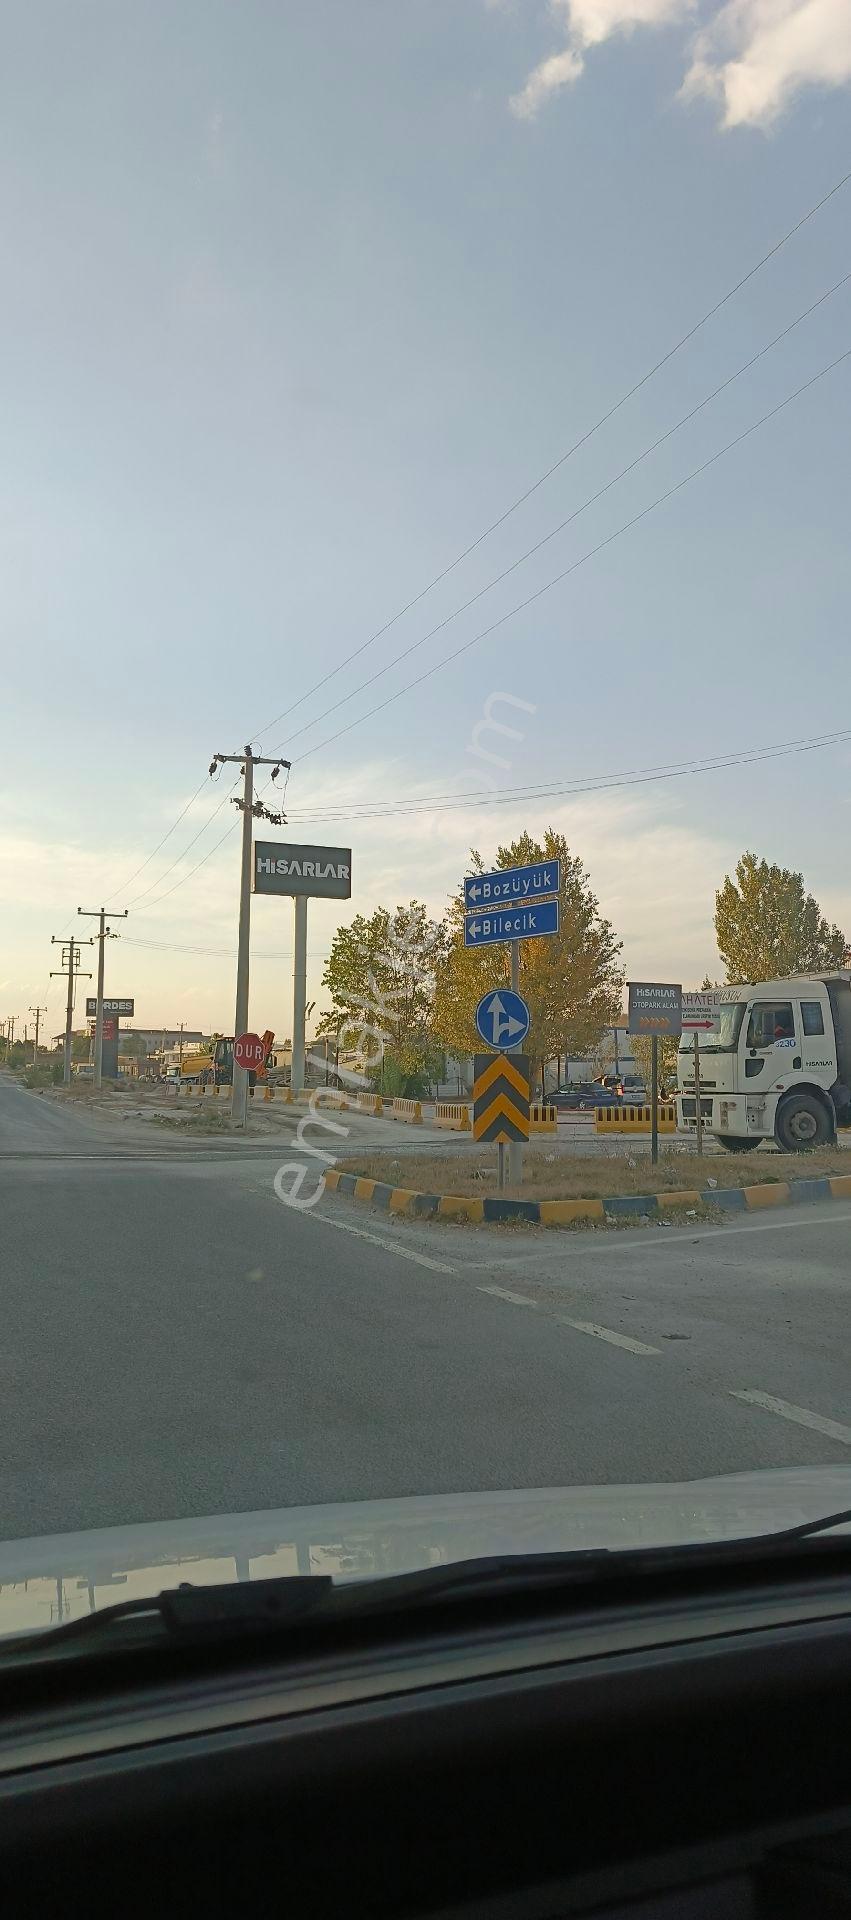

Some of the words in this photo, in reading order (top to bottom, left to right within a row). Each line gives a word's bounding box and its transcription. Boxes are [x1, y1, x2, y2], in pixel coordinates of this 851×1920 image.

[483, 870, 551, 898] Bozüyük
[483, 913, 537, 936] Bilecik
[88, 1001, 133, 1010] BRDES
[632, 1001, 661, 1009] OTOPARK
[235, 1043, 263, 1060] DUR
